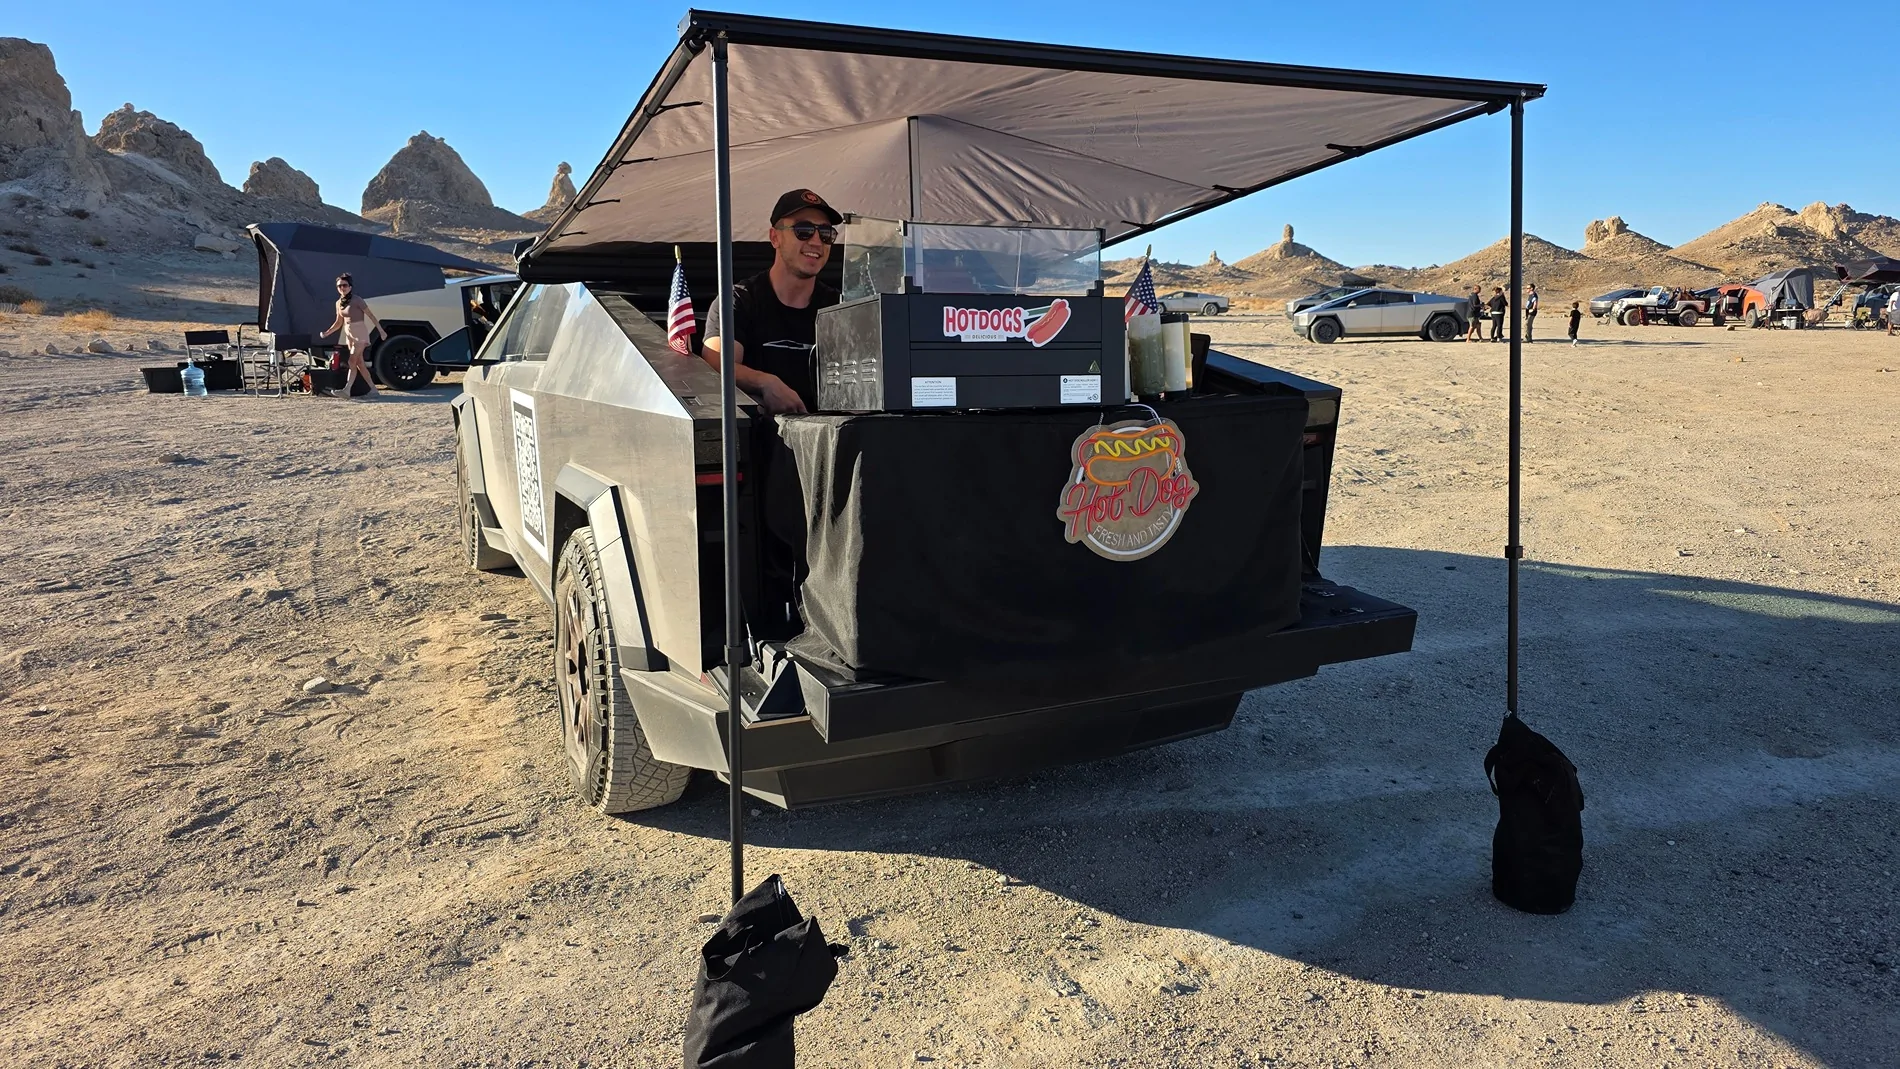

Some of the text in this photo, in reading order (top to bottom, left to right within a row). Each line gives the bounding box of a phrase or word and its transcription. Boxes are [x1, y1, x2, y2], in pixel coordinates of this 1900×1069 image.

[945, 308, 1022, 333] HOTDOGS
[1063, 467, 1194, 537] Hot Dog
[1092, 507, 1175, 547] FRESH AND TASTY
